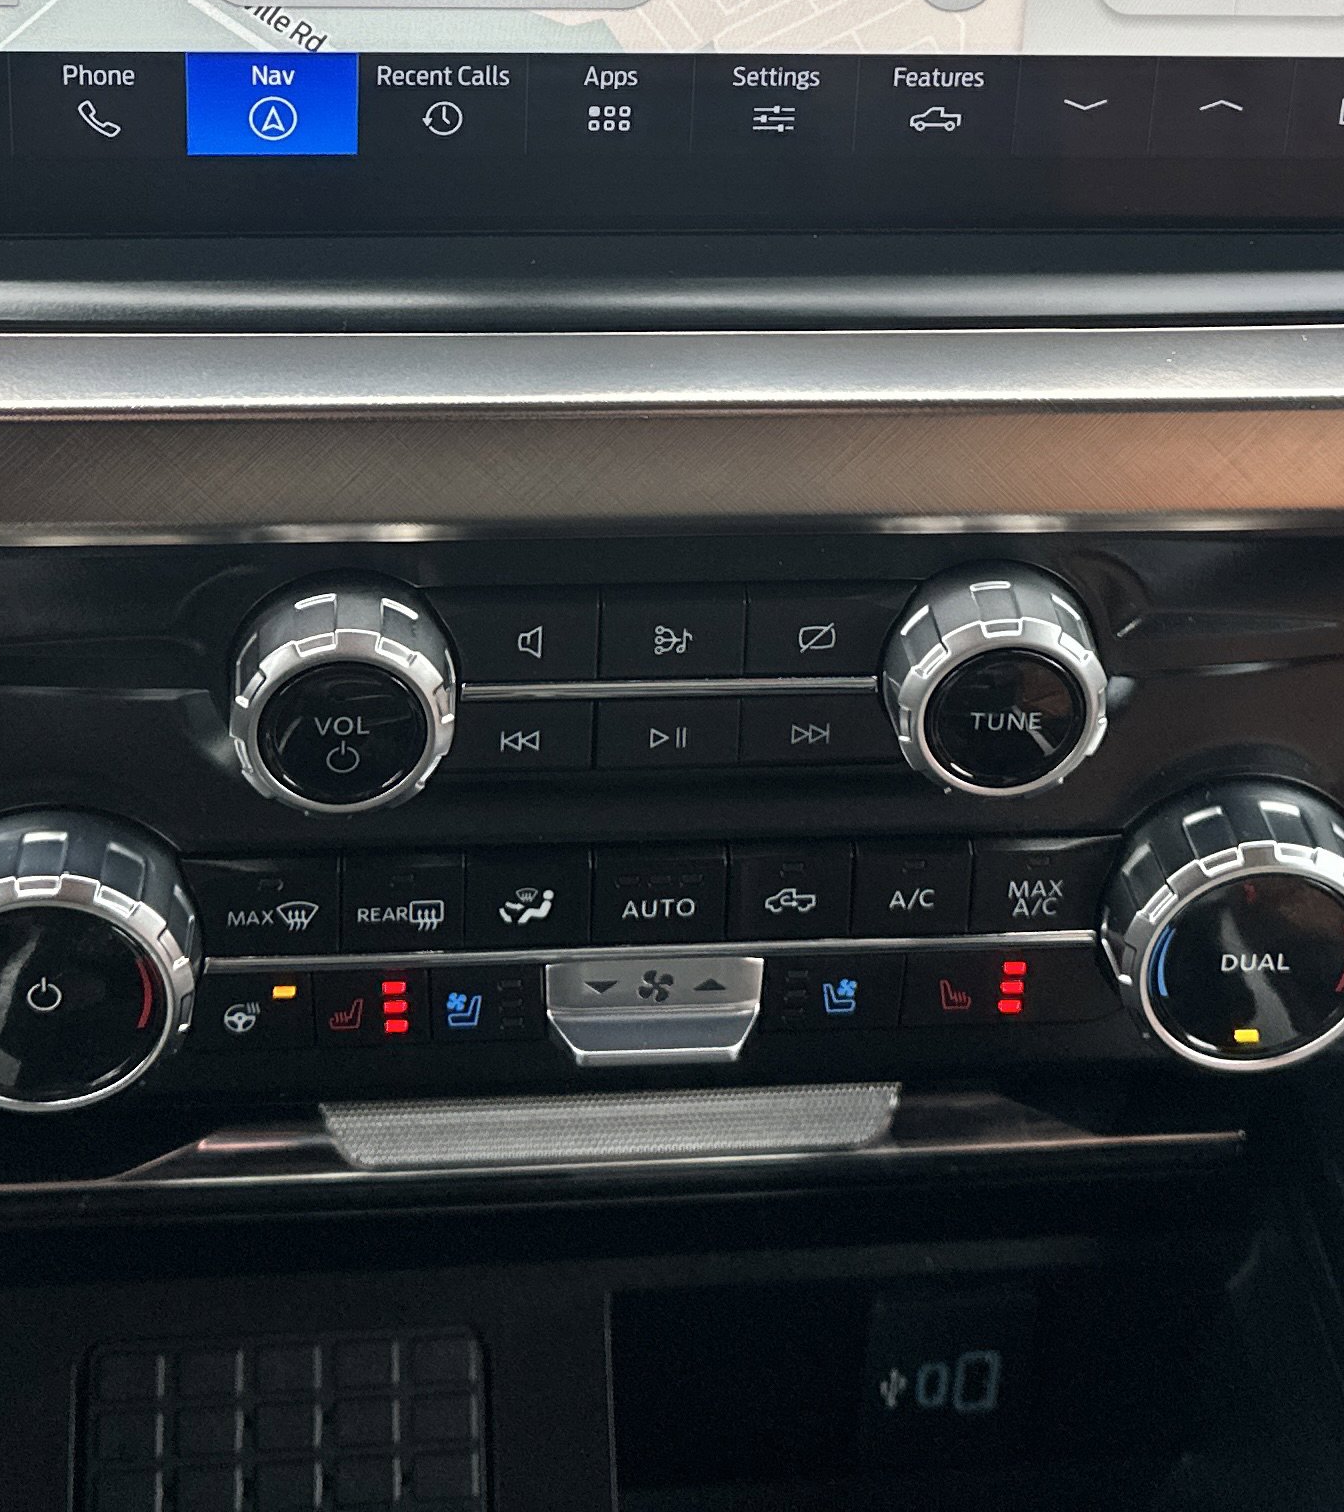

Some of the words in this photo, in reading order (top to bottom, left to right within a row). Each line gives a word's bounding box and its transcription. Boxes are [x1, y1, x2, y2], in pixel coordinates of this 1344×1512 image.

[289, 21, 328, 52] Rd
[62, 64, 135, 86] Phone
[252, 64, 296, 86] Nav
[377, 65, 453, 86] Recent
[457, 64, 510, 86] Calls
[583, 65, 638, 90] Apps
[732, 66, 820, 91] Settings
[893, 66, 985, 88] Features
[314, 715, 370, 736] VOL
[970, 711, 1043, 732] TUNE
[889, 888, 935, 910] A/C
[1008, 879, 1063, 901] MAX
[227, 909, 274, 926] MAX
[357, 906, 408, 923] REAR
[621, 897, 695, 919] AUTO
[1012, 897, 1057, 917] A/C
[1221, 953, 1290, 974] DUAL
